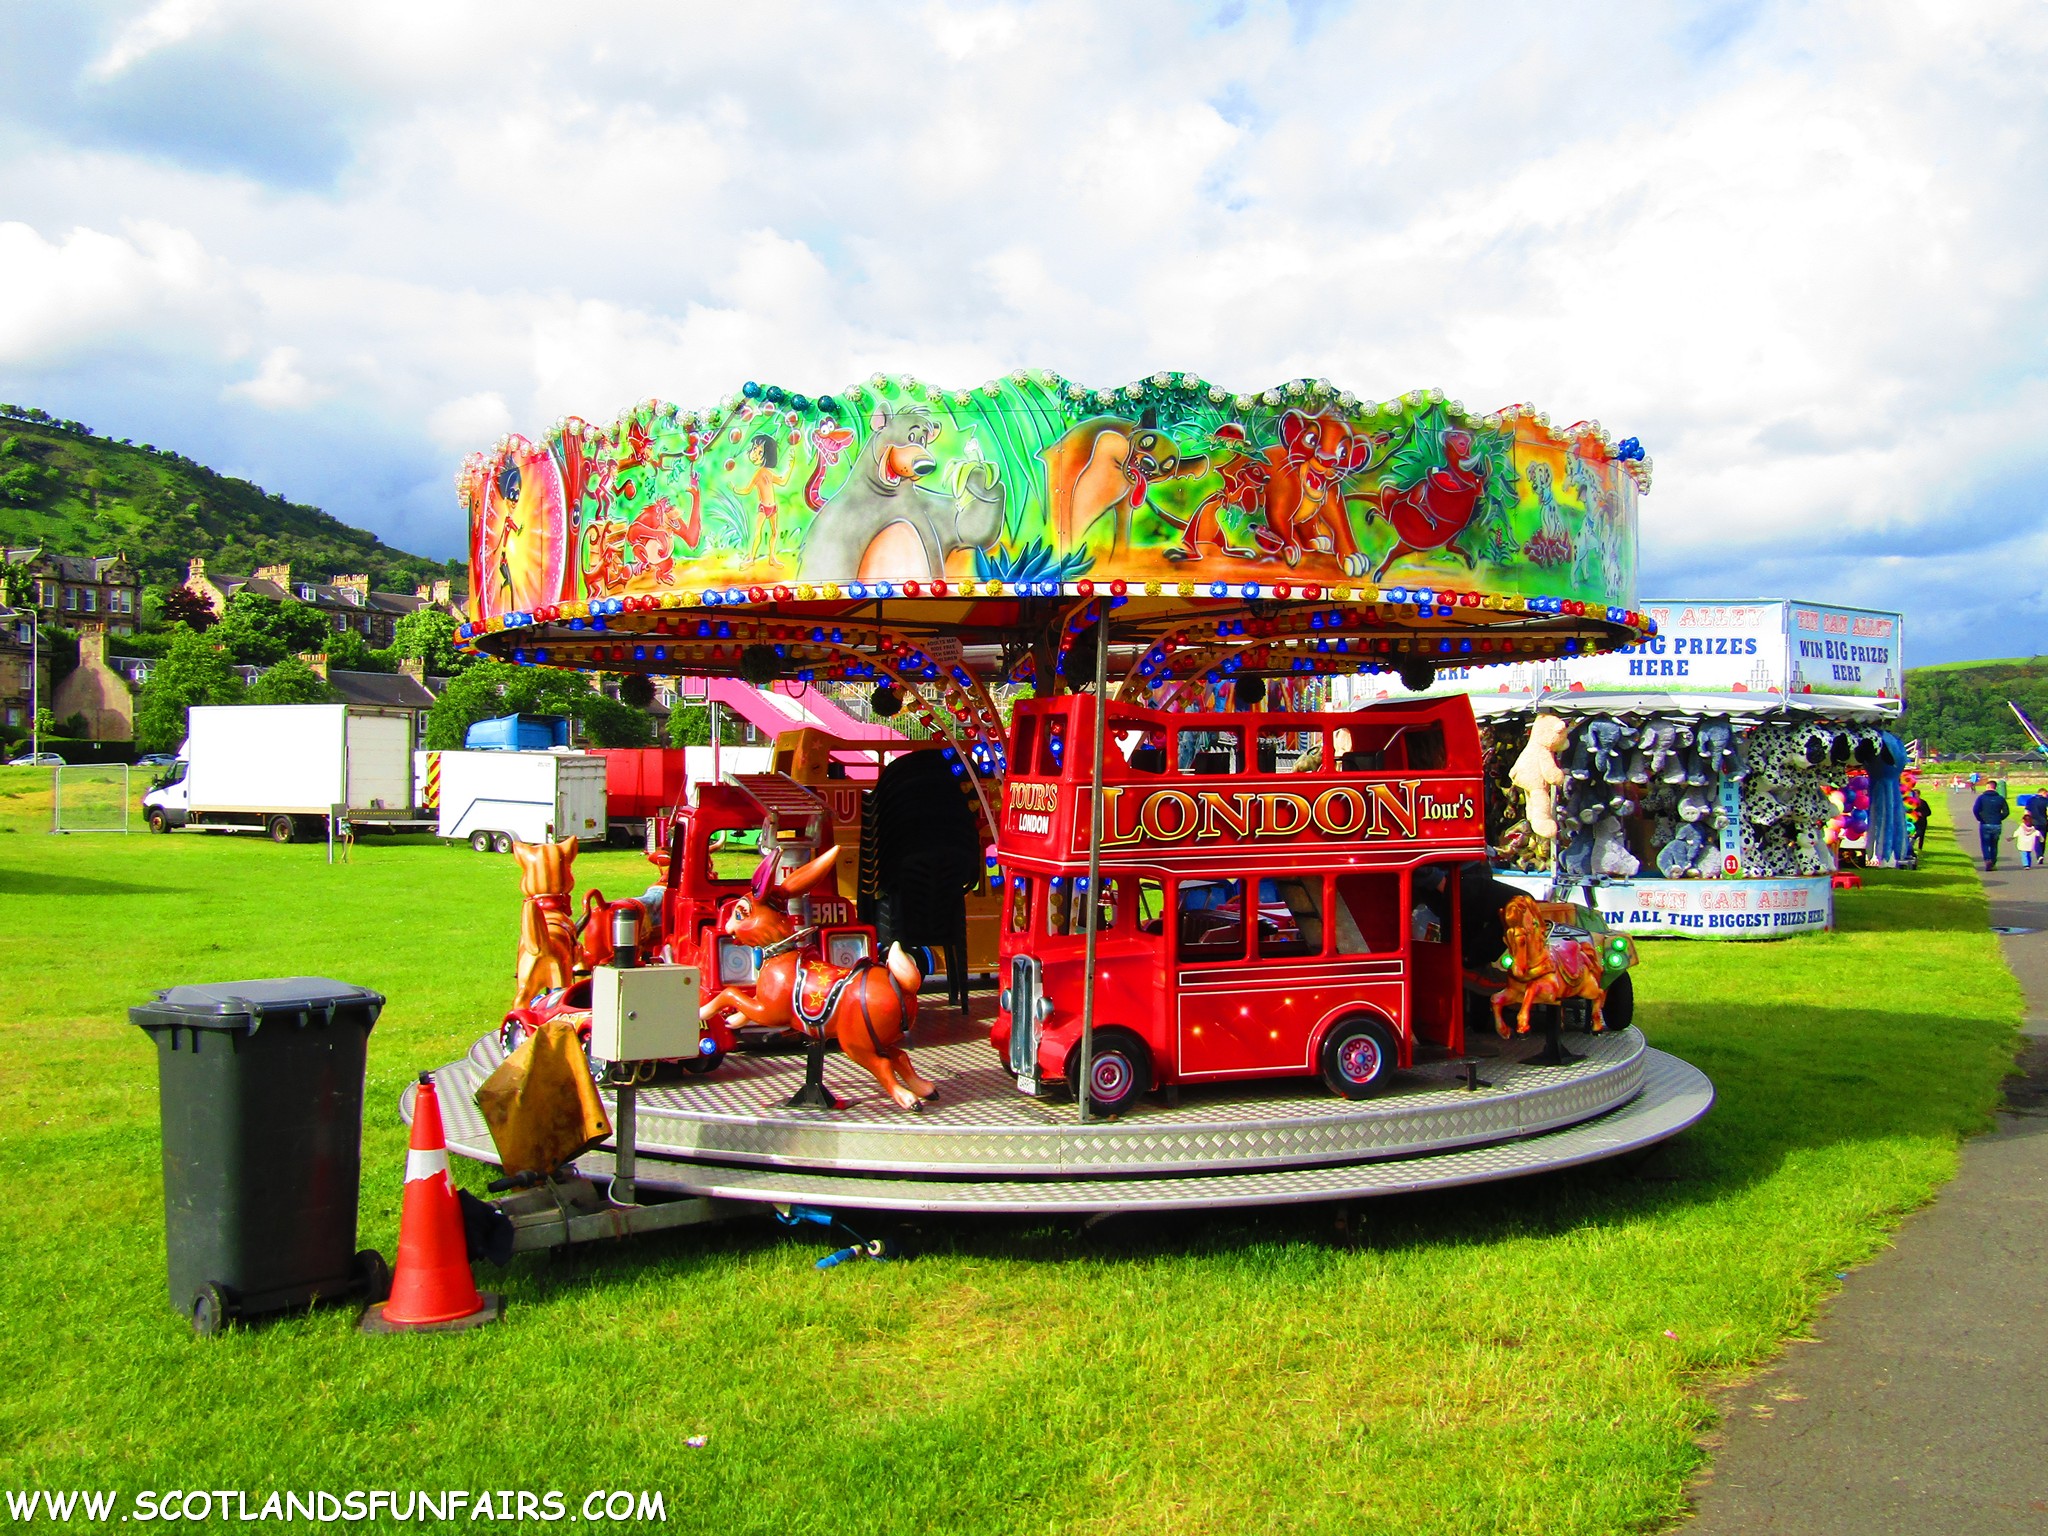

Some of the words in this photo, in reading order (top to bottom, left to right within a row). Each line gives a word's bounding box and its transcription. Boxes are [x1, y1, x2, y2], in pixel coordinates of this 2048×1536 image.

[1677, 606, 1765, 628] ALLEY
[1796, 609, 1819, 631] TIN
[1823, 613, 1848, 635] CAN
[1852, 616, 1893, 638] ALLEY
[1674, 637, 1757, 655] PRIZES
[1799, 640, 1823, 658] WIN
[1824, 639, 1848, 661] BIG
[1850, 645, 1889, 664] PRIZES
[1437, 666, 1469, 681] ERE
[1629, 659, 1689, 676] HERE
[1831, 664, 1861, 682] HERE
[1009, 782, 1058, 812] TOUR'S
[1018, 813, 1049, 835] LONDON
[1100, 779, 1421, 847] LONDON
[1420, 793, 1474, 820] Tour's
[1726, 860, 1737, 870] £1
[1637, 890, 1688, 910] TIN
[1700, 890, 1748, 911] CAN
[1757, 888, 1808, 910] ALLEY
[1601, 911, 1625, 924] IN
[1629, 910, 1662, 923] ALL
[1668, 912, 1704, 928] THE
[1708, 913, 1770, 928] BIGGEST
[1773, 910, 1807, 927] PRIZES
[1807, 909, 1824, 924] HERE
